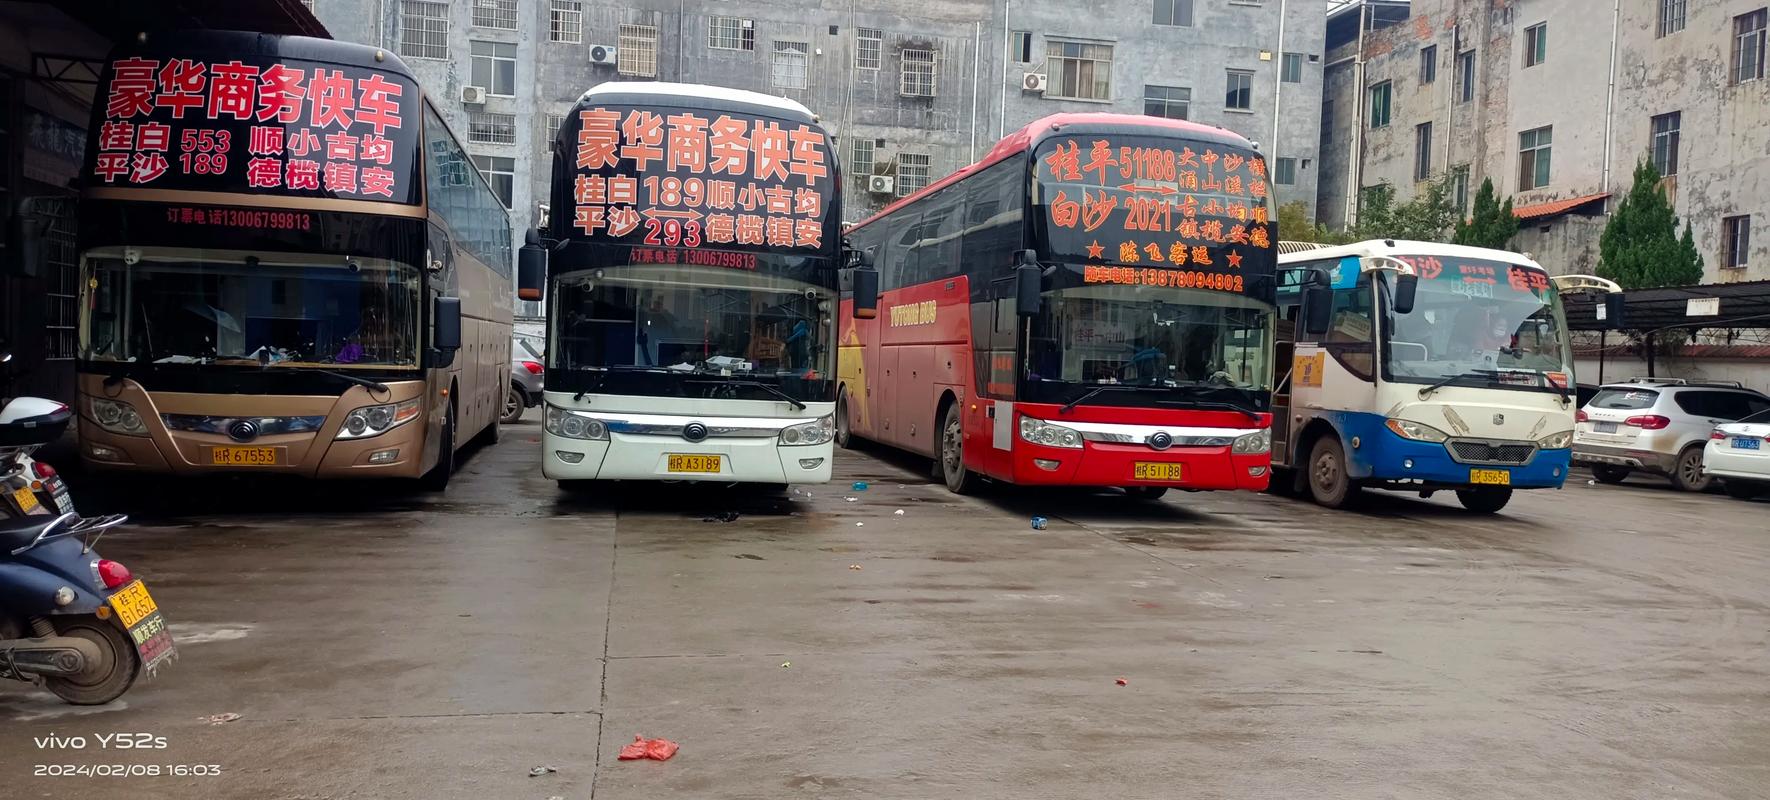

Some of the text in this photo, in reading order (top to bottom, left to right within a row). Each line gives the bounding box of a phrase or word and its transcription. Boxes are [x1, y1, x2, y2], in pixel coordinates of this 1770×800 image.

[106, 56, 403, 135] 豪华商务快车
[180, 129, 231, 154] 553
[575, 107, 827, 186] 豪华商务快车
[178, 152, 228, 176] 189
[1045, 140, 1119, 188] 桂平
[1119, 147, 1176, 182] 51188
[1201, 149, 1222, 192] 中山
[642, 175, 706, 207] 189
[1051, 190, 1118, 232] 白沙
[1124, 196, 1171, 232] 2021
[1175, 193, 1200, 240] 古镇
[643, 219, 701, 247] 293
[683, 249, 756, 270] 13006799813
[1119, 240, 1214, 266] 陈飞客运
[890, 299, 938, 327] YUTONG BUS
